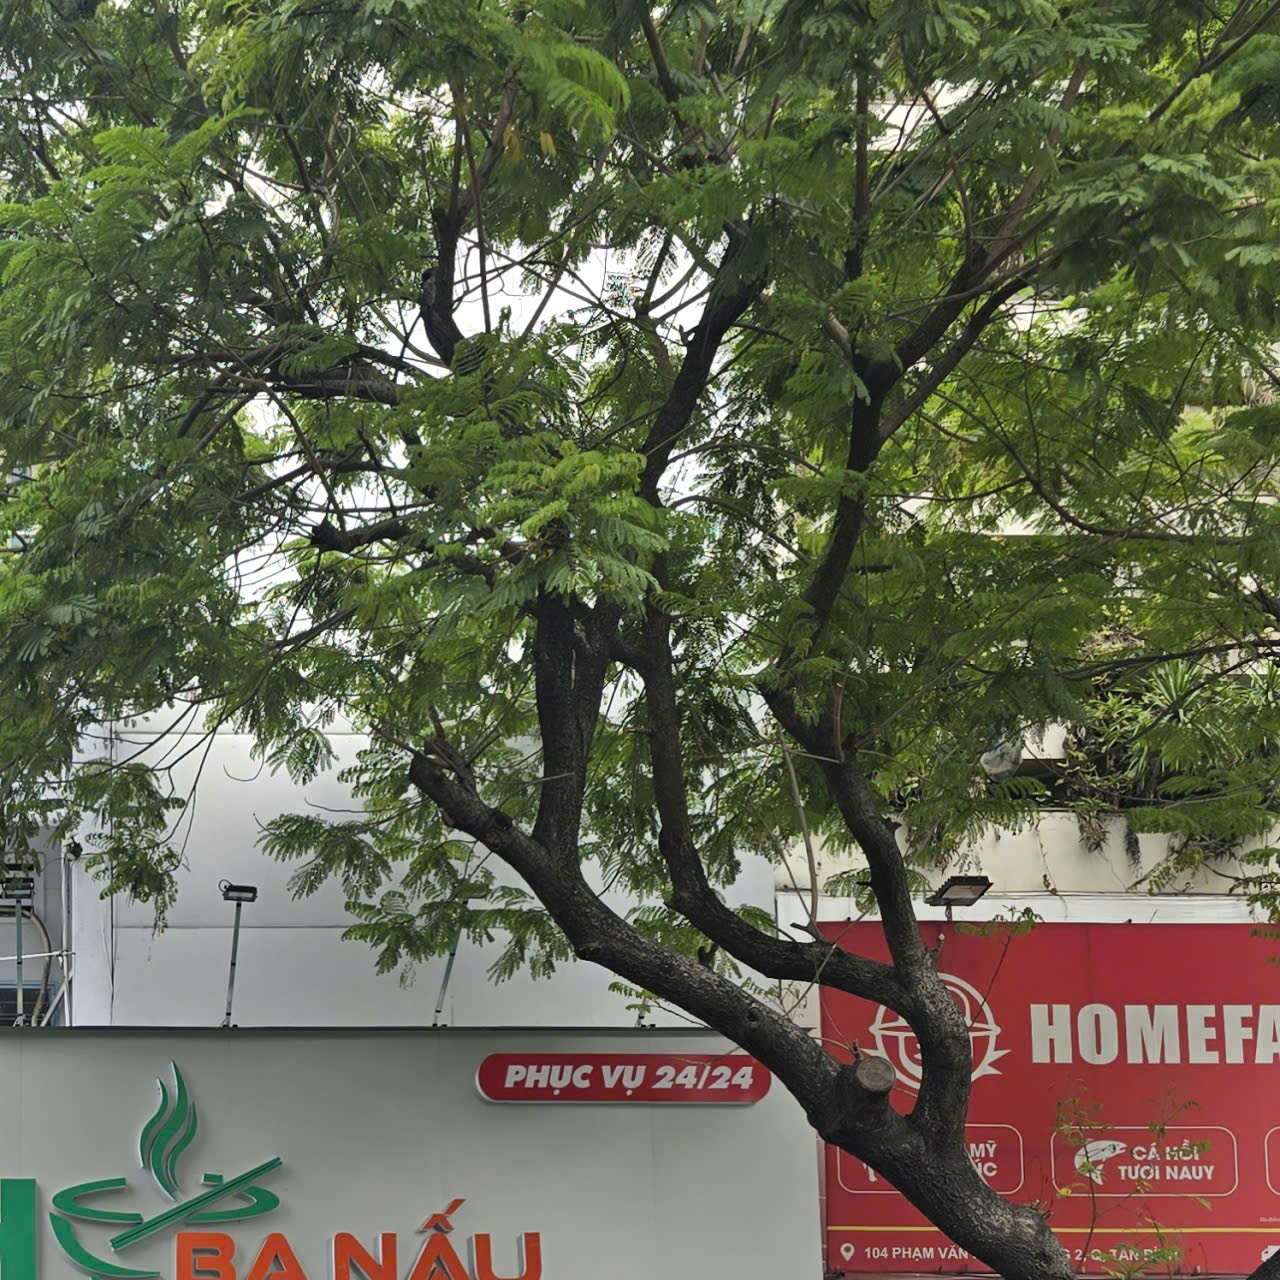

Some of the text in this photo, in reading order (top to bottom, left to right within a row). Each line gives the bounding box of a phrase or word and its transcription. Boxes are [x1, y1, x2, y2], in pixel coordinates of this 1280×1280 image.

[504, 1065, 753, 1096] PHỤC VỤ 24/24
[970, 1139, 997, 1158] MỸ
[1132, 1142, 1160, 1161] CÁ
[1118, 1164, 1215, 1181] TƯƠI NAUY
[864, 1246, 888, 1259] 104
[892, 1246, 938, 1262] PHẠM
